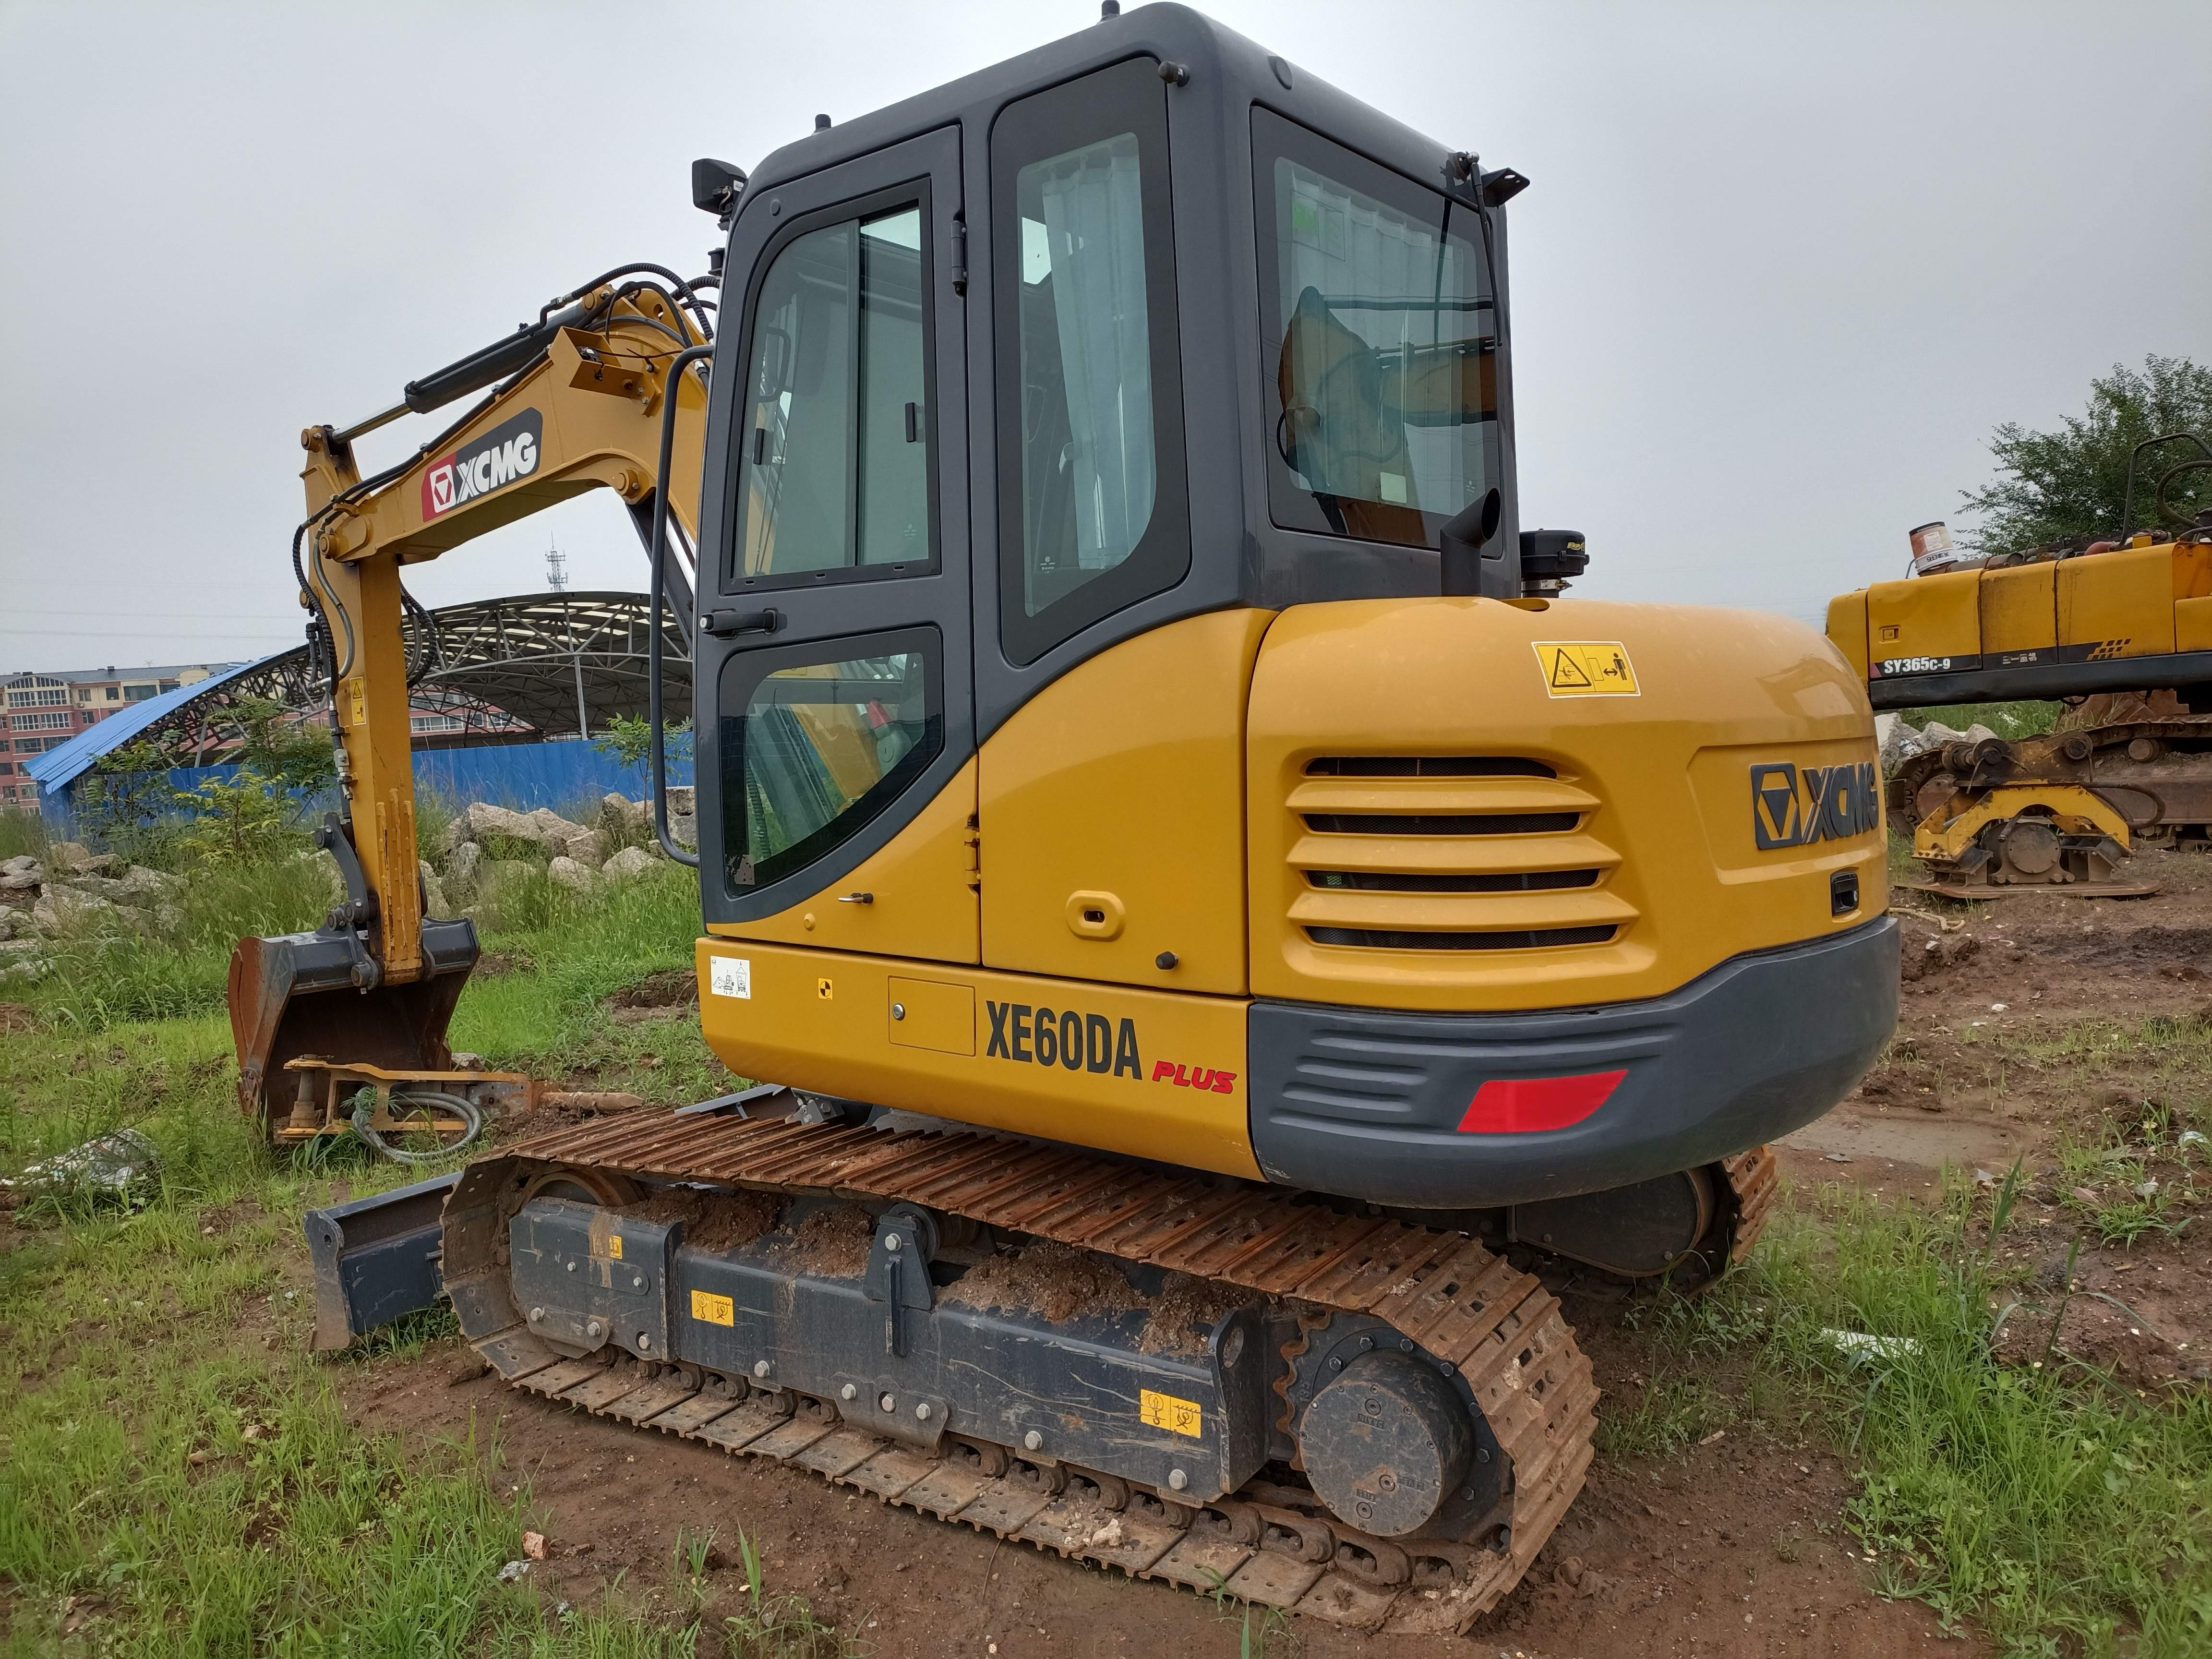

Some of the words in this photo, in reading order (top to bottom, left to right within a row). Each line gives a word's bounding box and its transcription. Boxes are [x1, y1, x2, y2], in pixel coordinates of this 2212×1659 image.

[457, 432, 536, 504] XCMG
[1801, 762, 1879, 844] XCMG
[986, 1000, 1143, 1081] XE60DA
[1152, 1060, 1238, 1094] PLUS
[1358, 1414, 1384, 1429] DRAIN
